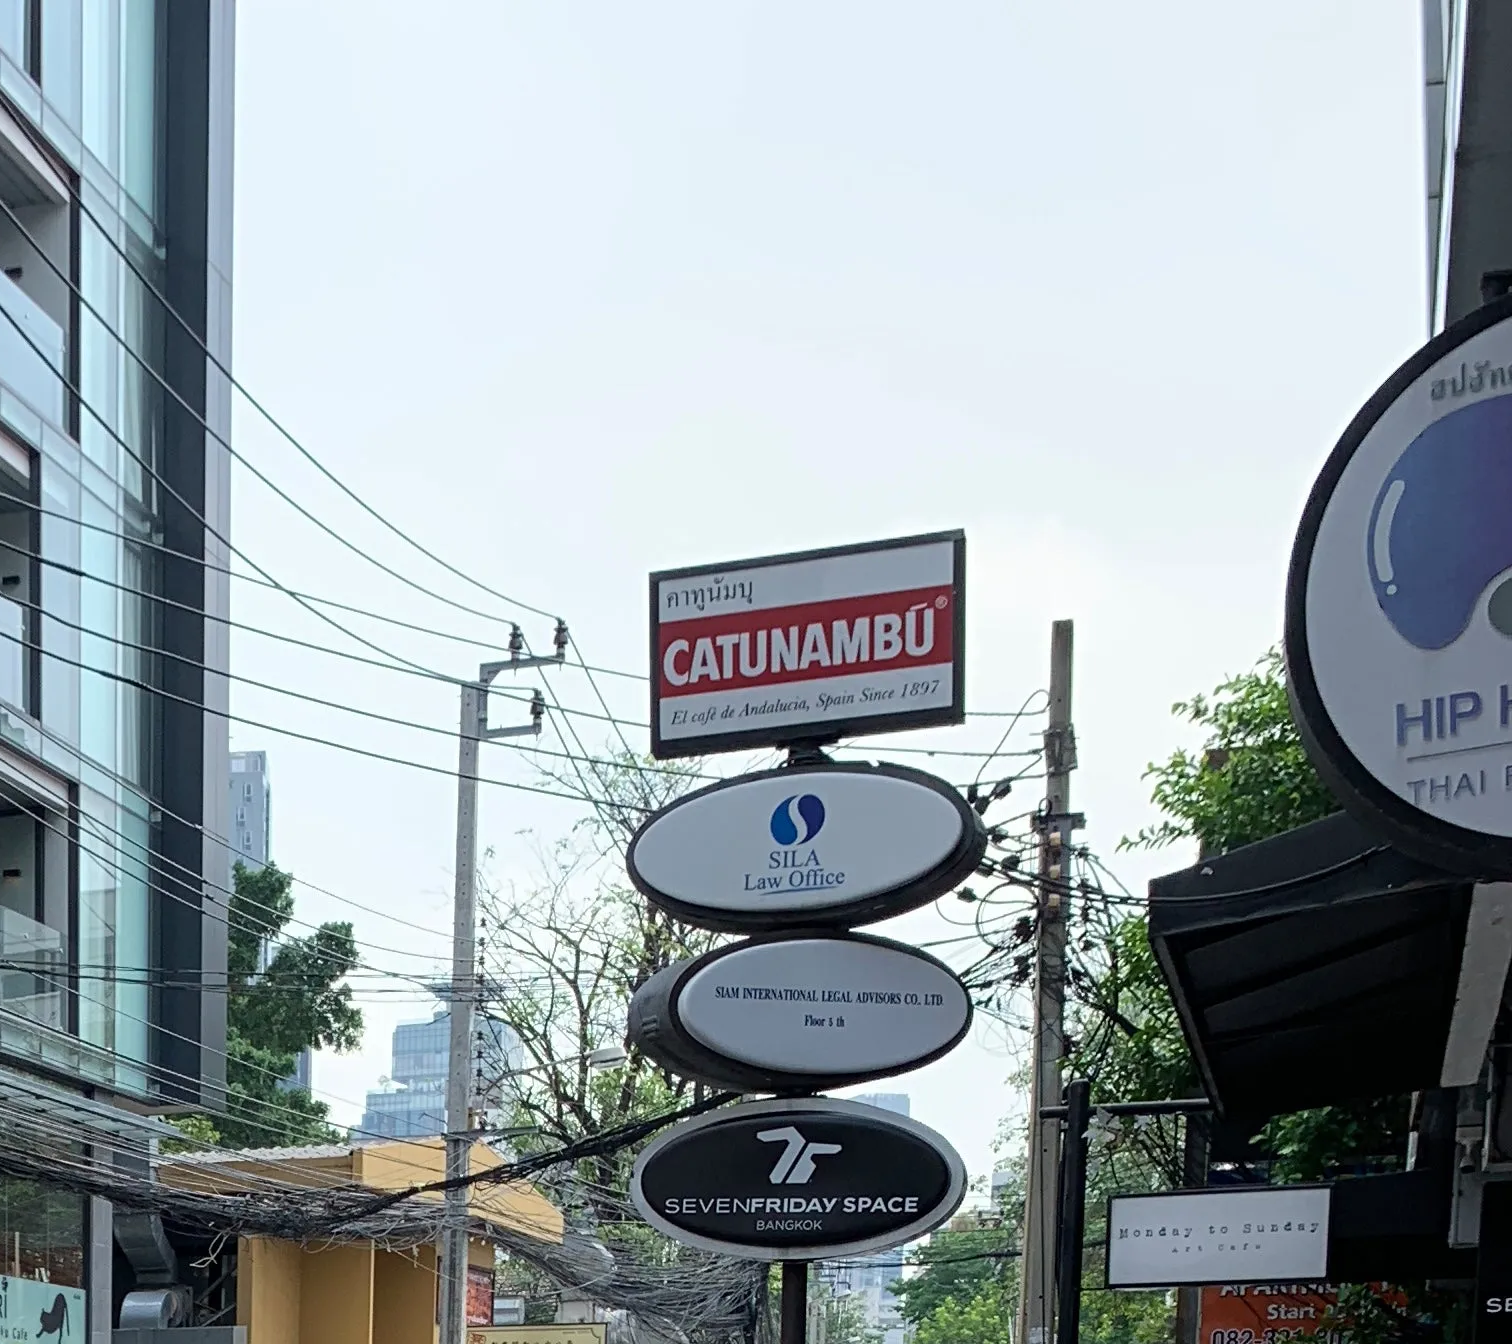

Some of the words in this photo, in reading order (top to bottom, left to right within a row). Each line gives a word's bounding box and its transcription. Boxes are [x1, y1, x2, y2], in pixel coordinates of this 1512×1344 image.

[671, 710, 688, 725] El
[721, 705, 735, 719] de
[816, 690, 855, 711] Spain
[859, 687, 895, 703] Since
[900, 680, 941, 698] 1897
[1396, 690, 1483, 748] HIP
[1407, 769, 1486, 806] THAI
[769, 849, 822, 869] SILA
[744, 873, 783, 891] Law
[789, 868, 846, 888] Office
[715, 986, 740, 999] SIAM
[743, 987, 818, 1002] INTERNATIONAL
[821, 990, 853, 1003] LEGAL
[855, 990, 902, 1005] ADVISORS
[804, 1014, 825, 1027] Floor
[828, 1017, 833, 1027] 5
[836, 1016, 845, 1027] th
[665, 1196, 837, 1214] SEVENFRIDAY
[842, 1196, 919, 1213] SPACE
[756, 1219, 822, 1231] BANGKOK
[1118, 1226, 1193, 1239] Monday
[1208, 1224, 1228, 1235] to
[1242, 1221, 1320, 1234] Sunday
[1267, 1303, 1316, 1320] Start
[12, 1327, 29, 1341] Cafe
